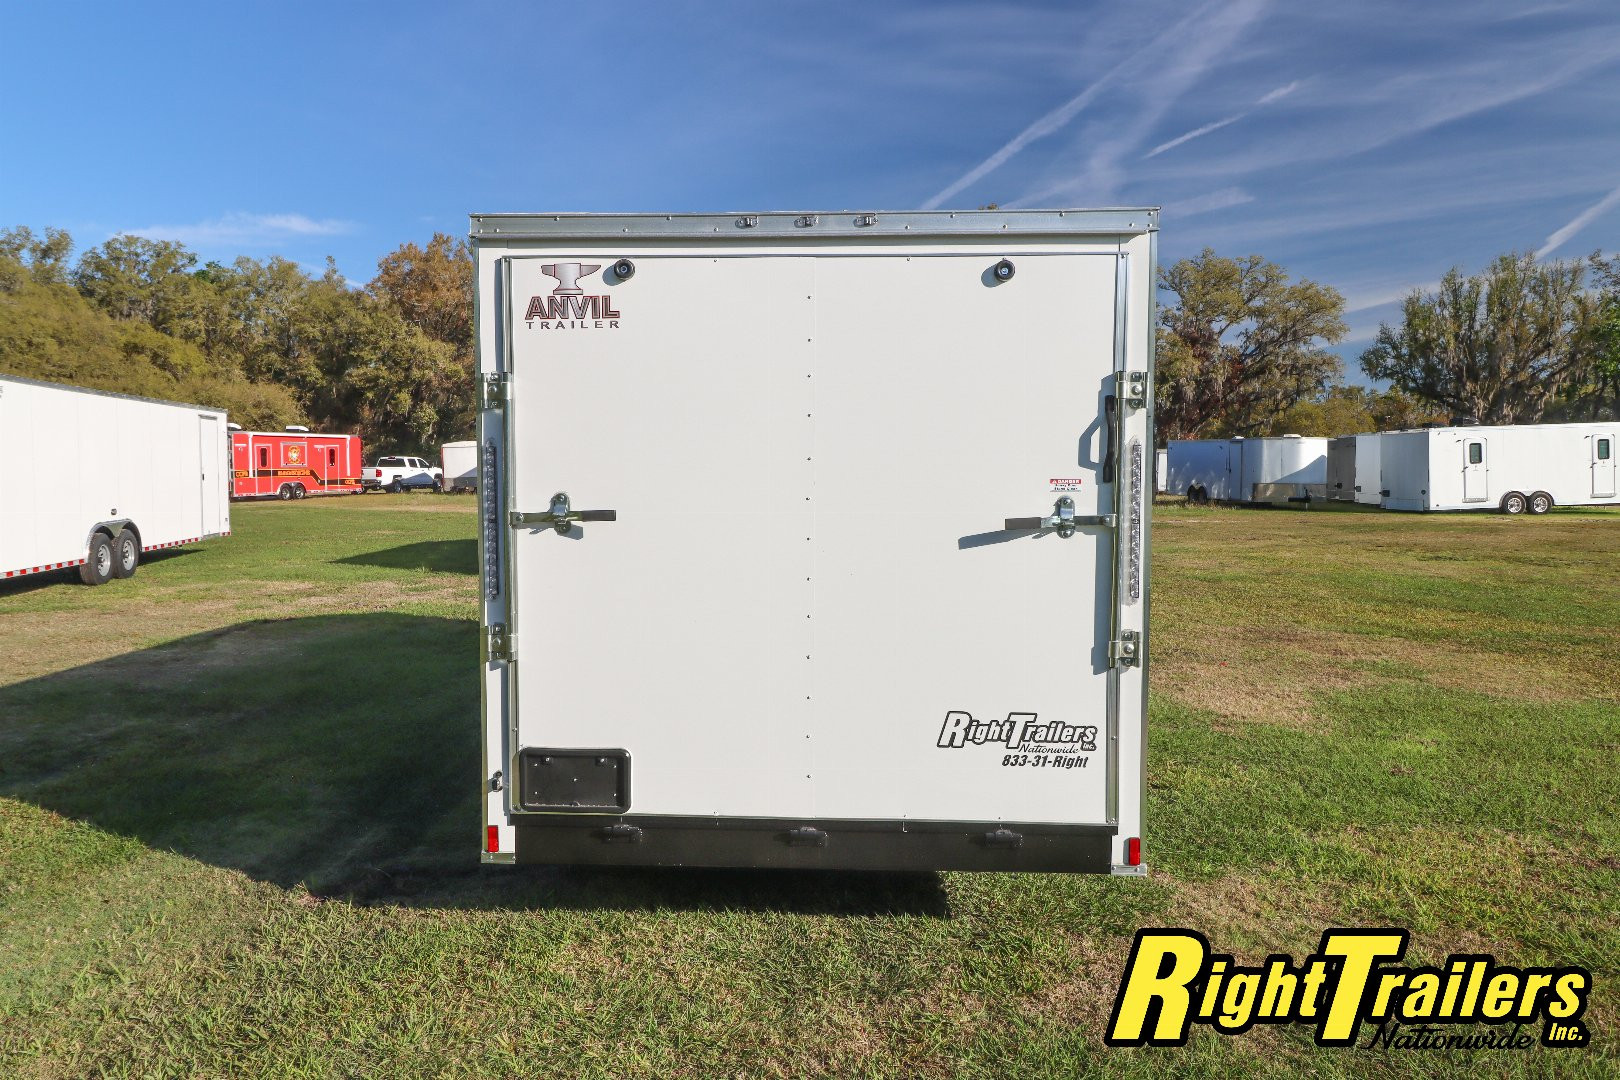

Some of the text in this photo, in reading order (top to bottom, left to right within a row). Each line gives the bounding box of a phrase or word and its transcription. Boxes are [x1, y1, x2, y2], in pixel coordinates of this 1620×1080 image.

[525, 295, 620, 320] ANVIL
[526, 320, 620, 329] TRAILER
[1018, 743, 1080, 754] Nationwide
[1001, 754, 1089, 769] 833-31-Right
